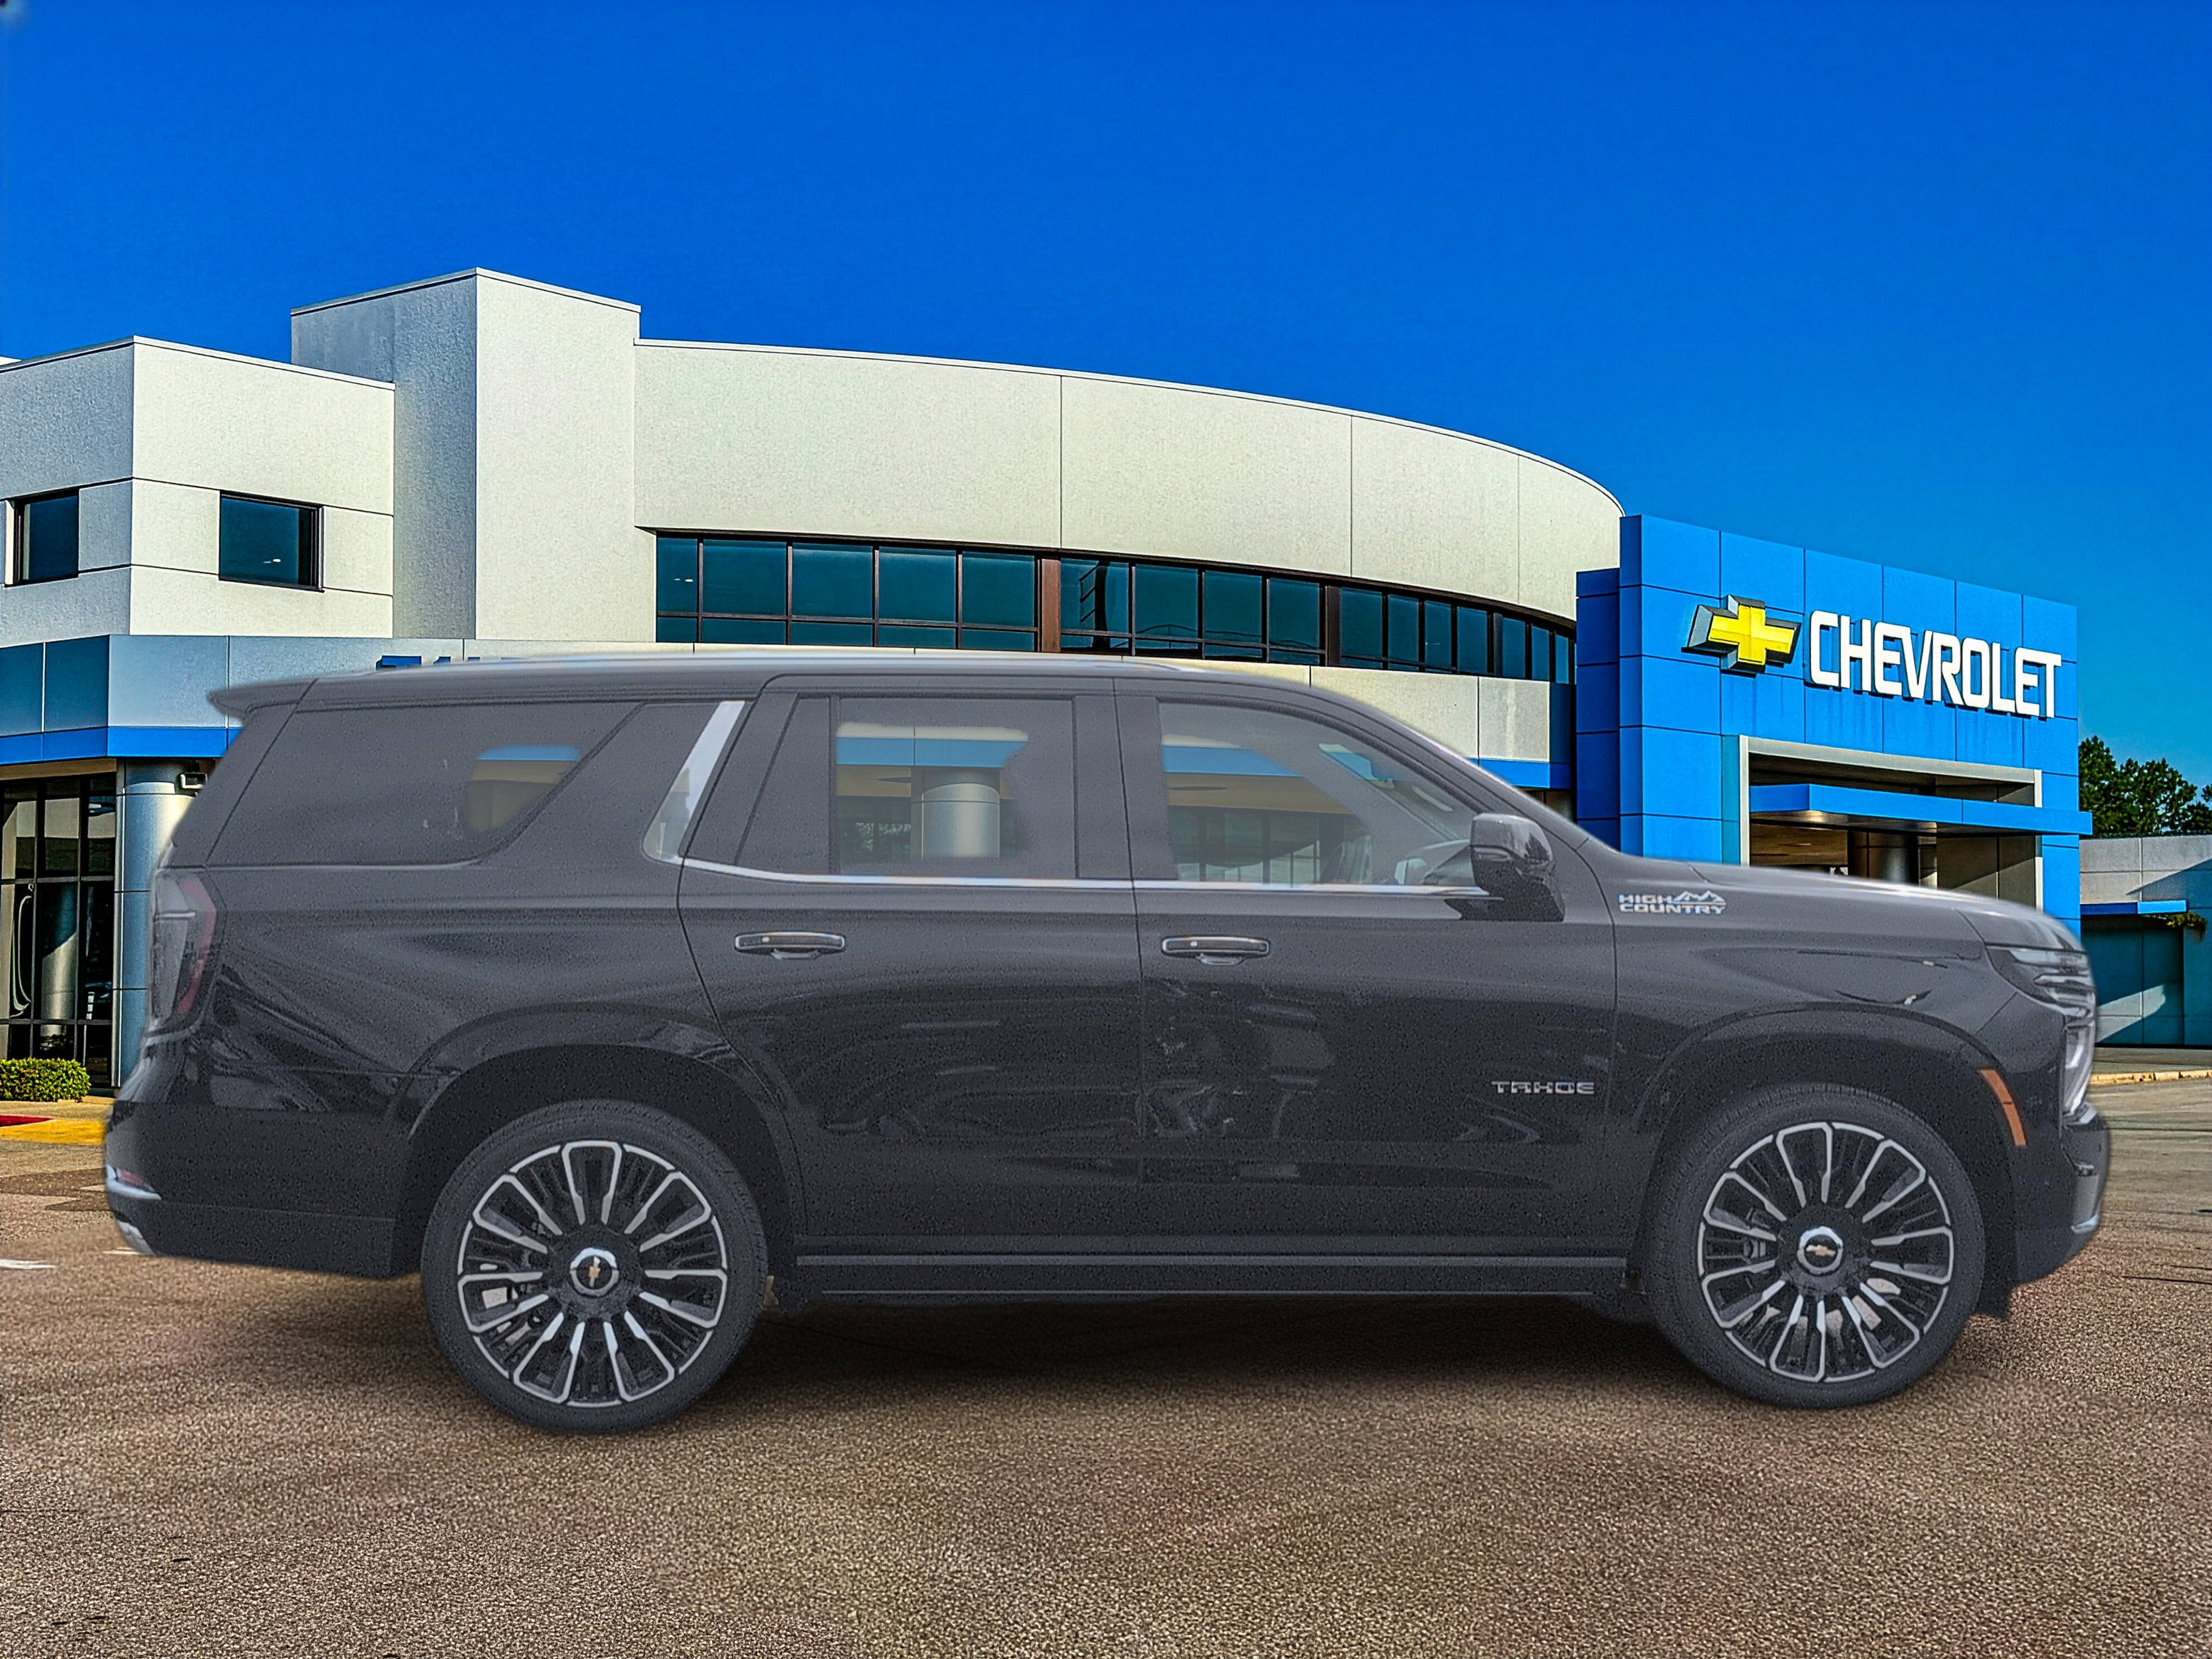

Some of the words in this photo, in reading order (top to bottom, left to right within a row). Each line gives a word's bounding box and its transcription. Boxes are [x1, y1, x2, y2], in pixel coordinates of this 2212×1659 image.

[1810, 610, 2062, 718] CHEVROLET
[1619, 893, 1672, 904] HIGH
[1619, 904, 1725, 914] COUNTRY
[1491, 1081, 1594, 1094] TAHOE
